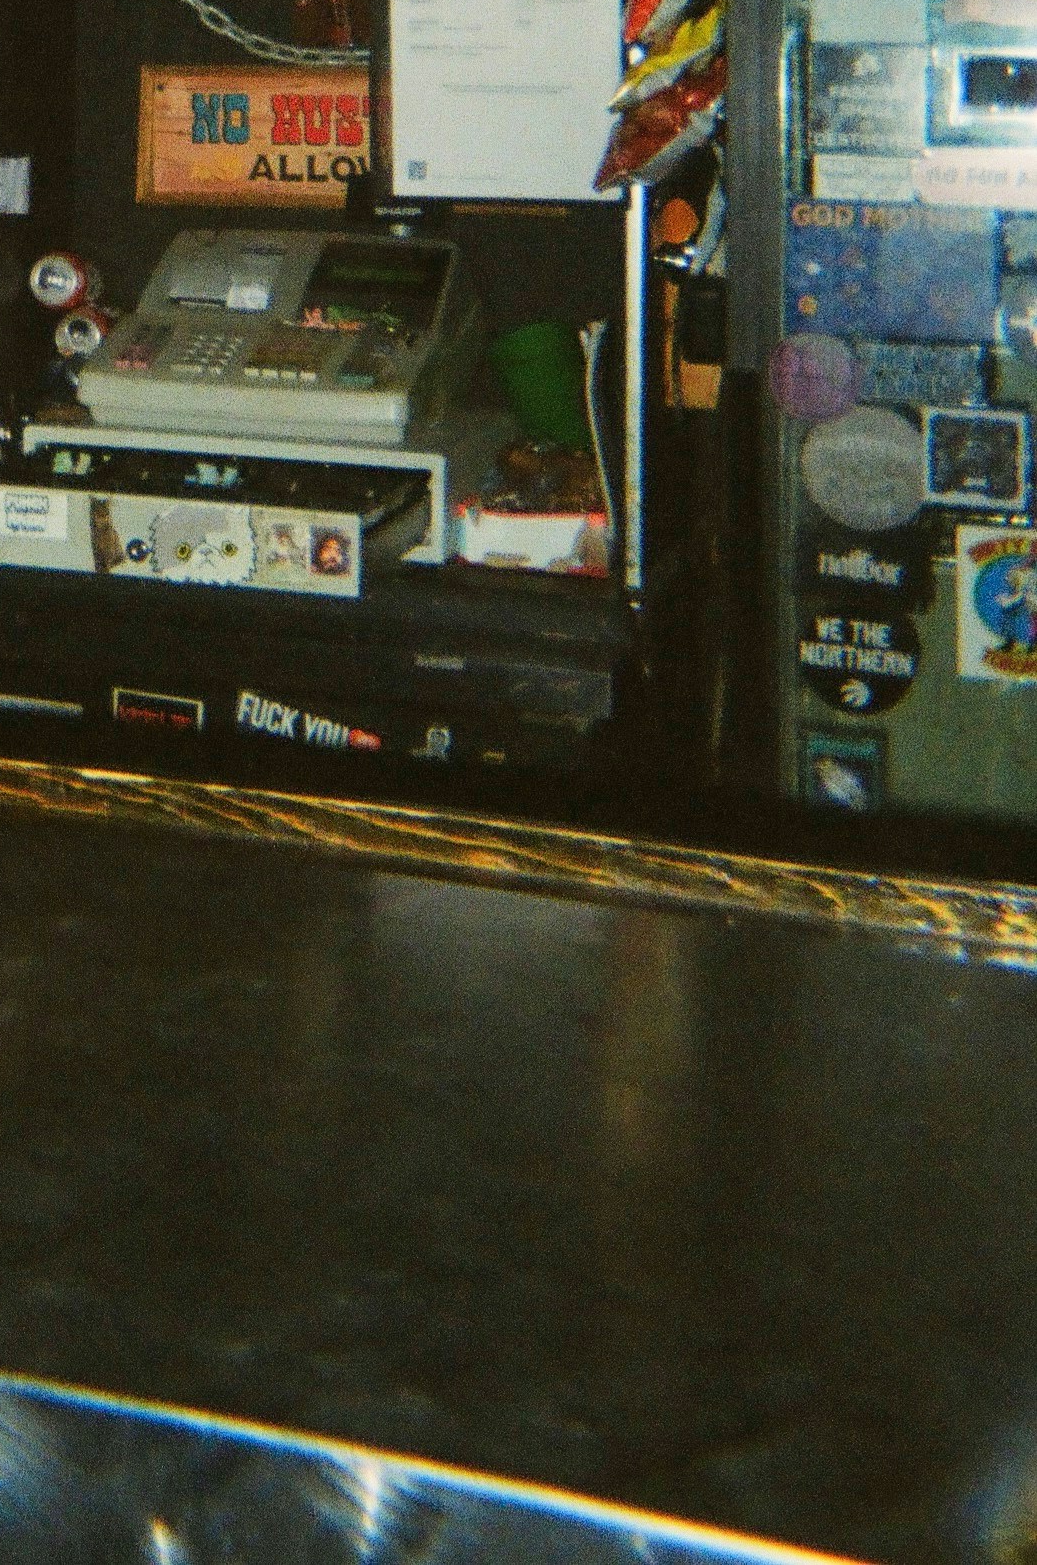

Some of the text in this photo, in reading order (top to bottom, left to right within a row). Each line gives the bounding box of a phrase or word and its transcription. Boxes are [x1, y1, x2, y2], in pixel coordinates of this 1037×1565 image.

[191, 92, 250, 145] NO
[814, 615, 892, 649] WE THE
[236, 689, 300, 740] FUCK
[303, 711, 350, 750] YOU
